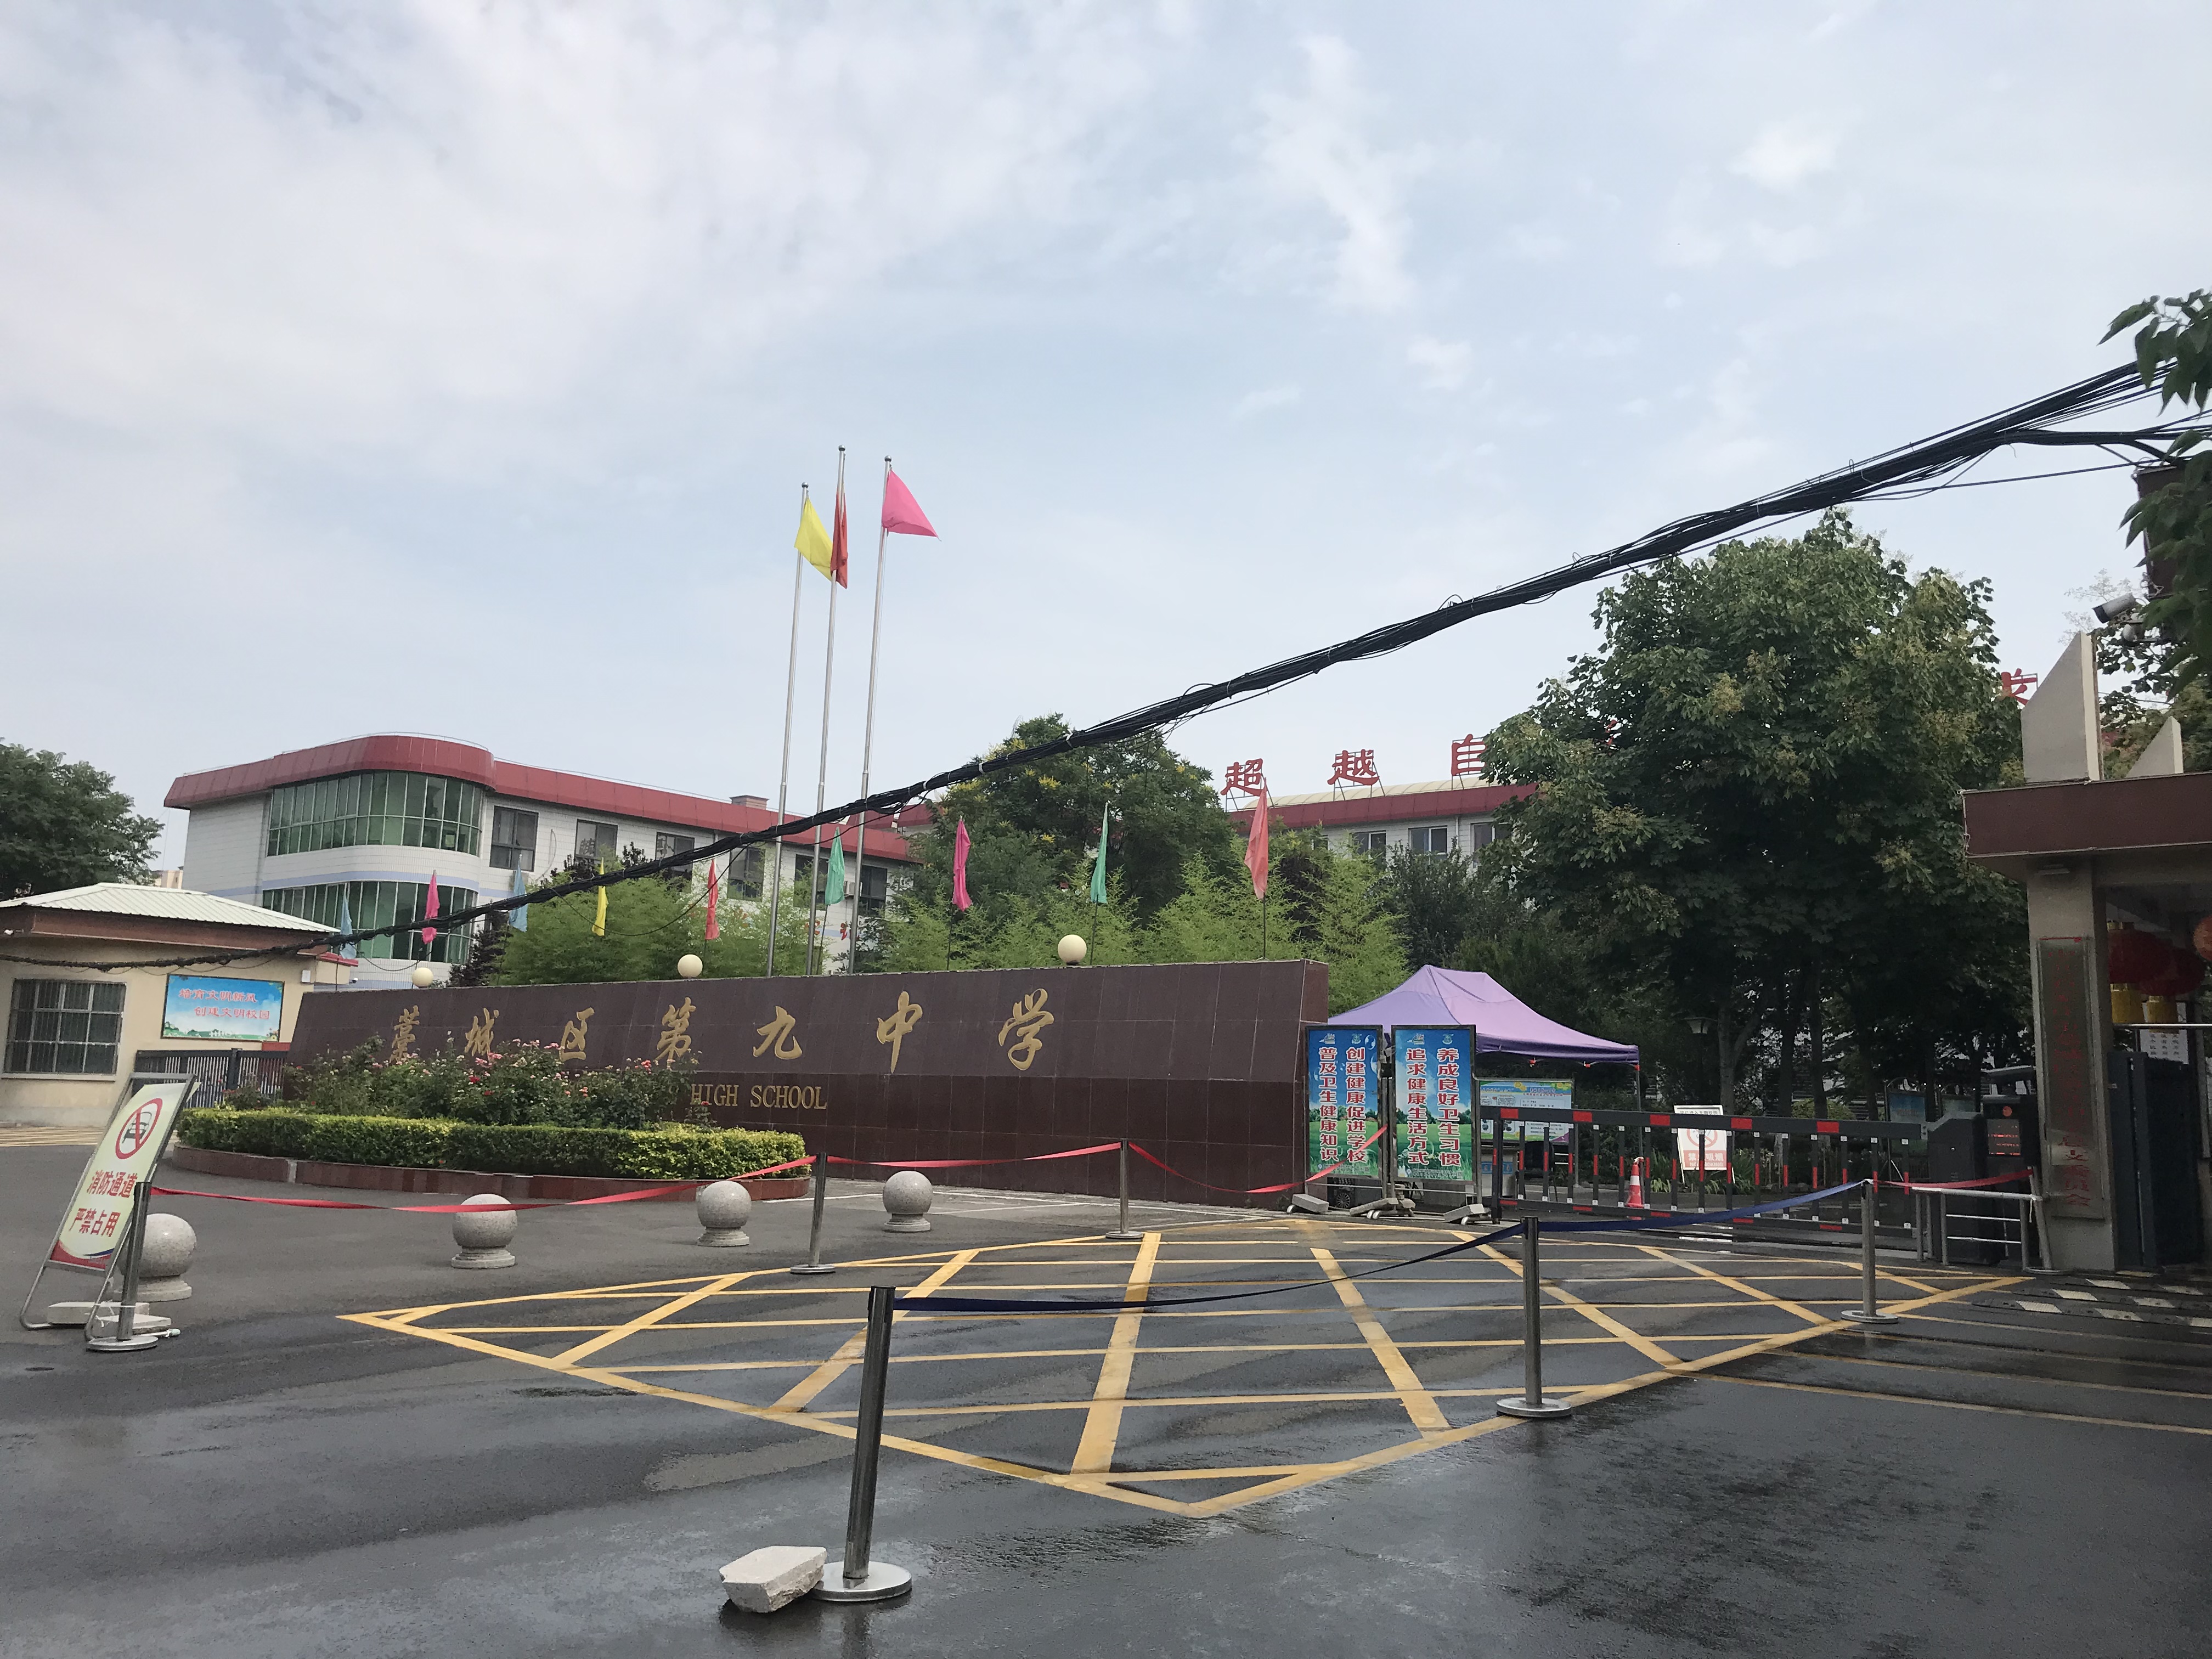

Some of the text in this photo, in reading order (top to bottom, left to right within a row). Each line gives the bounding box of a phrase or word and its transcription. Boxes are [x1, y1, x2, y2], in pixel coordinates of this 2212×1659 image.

[179, 988, 257, 1003] 培育文明新风
[194, 1006, 270, 1019] 创建文明校园
[690, 1083, 827, 1109] HIGH SCHOOL
[1319, 1047, 1338, 1161] 普及卫生健康知识
[1346, 1047, 1367, 1163] 创建健康促进学校
[1406, 1048, 1429, 1165] 追求健康生活方式
[1437, 1048, 1461, 1166] 养成良好卫生习惯
[87, 1170, 138, 1198] 消防通道
[69, 1208, 121, 1237] 严禁占用
